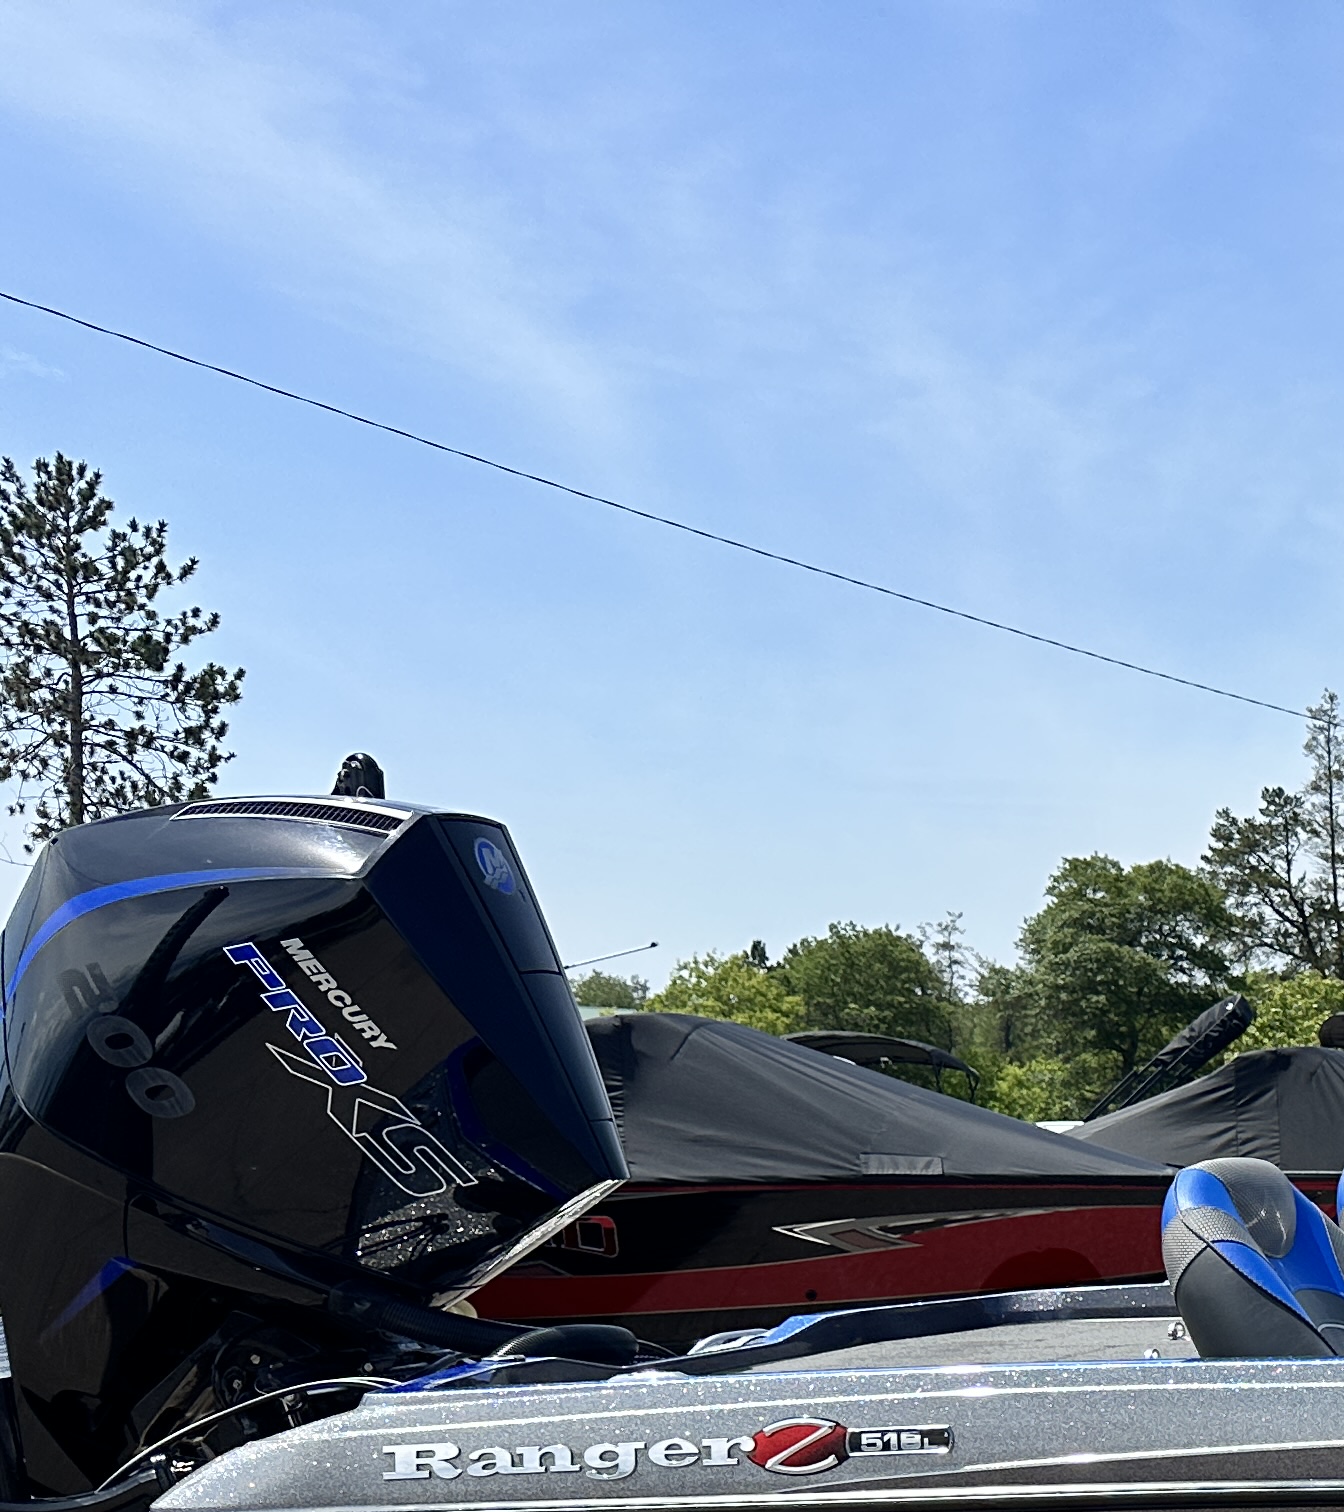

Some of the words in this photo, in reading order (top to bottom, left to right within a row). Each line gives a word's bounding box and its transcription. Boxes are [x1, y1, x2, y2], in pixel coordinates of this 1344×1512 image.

[223, 941, 368, 1086] PRO
[280, 938, 398, 1050] MERCURY
[265, 1032, 479, 1197] XS
[381, 1432, 756, 1482] Ranger
